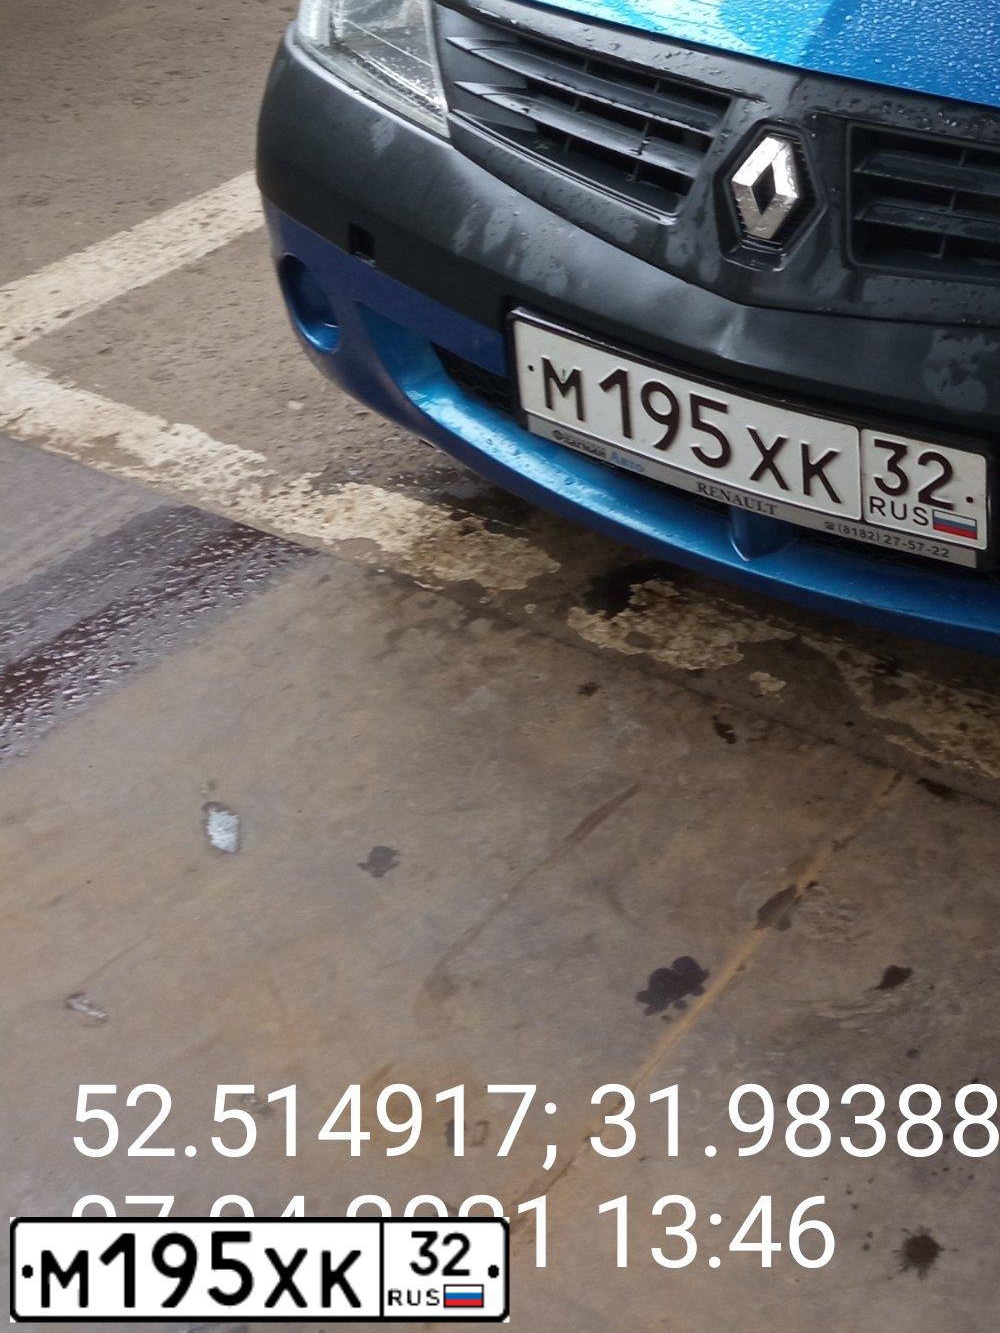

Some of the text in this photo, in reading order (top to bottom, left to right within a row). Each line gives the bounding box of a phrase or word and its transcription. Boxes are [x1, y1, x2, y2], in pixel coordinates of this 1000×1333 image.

[873, 438, 954, 510] 32
[697, 481, 778, 516] RENAULT
[869, 495, 929, 527] RUS
[883, 534, 950, 558] 27-57-22
